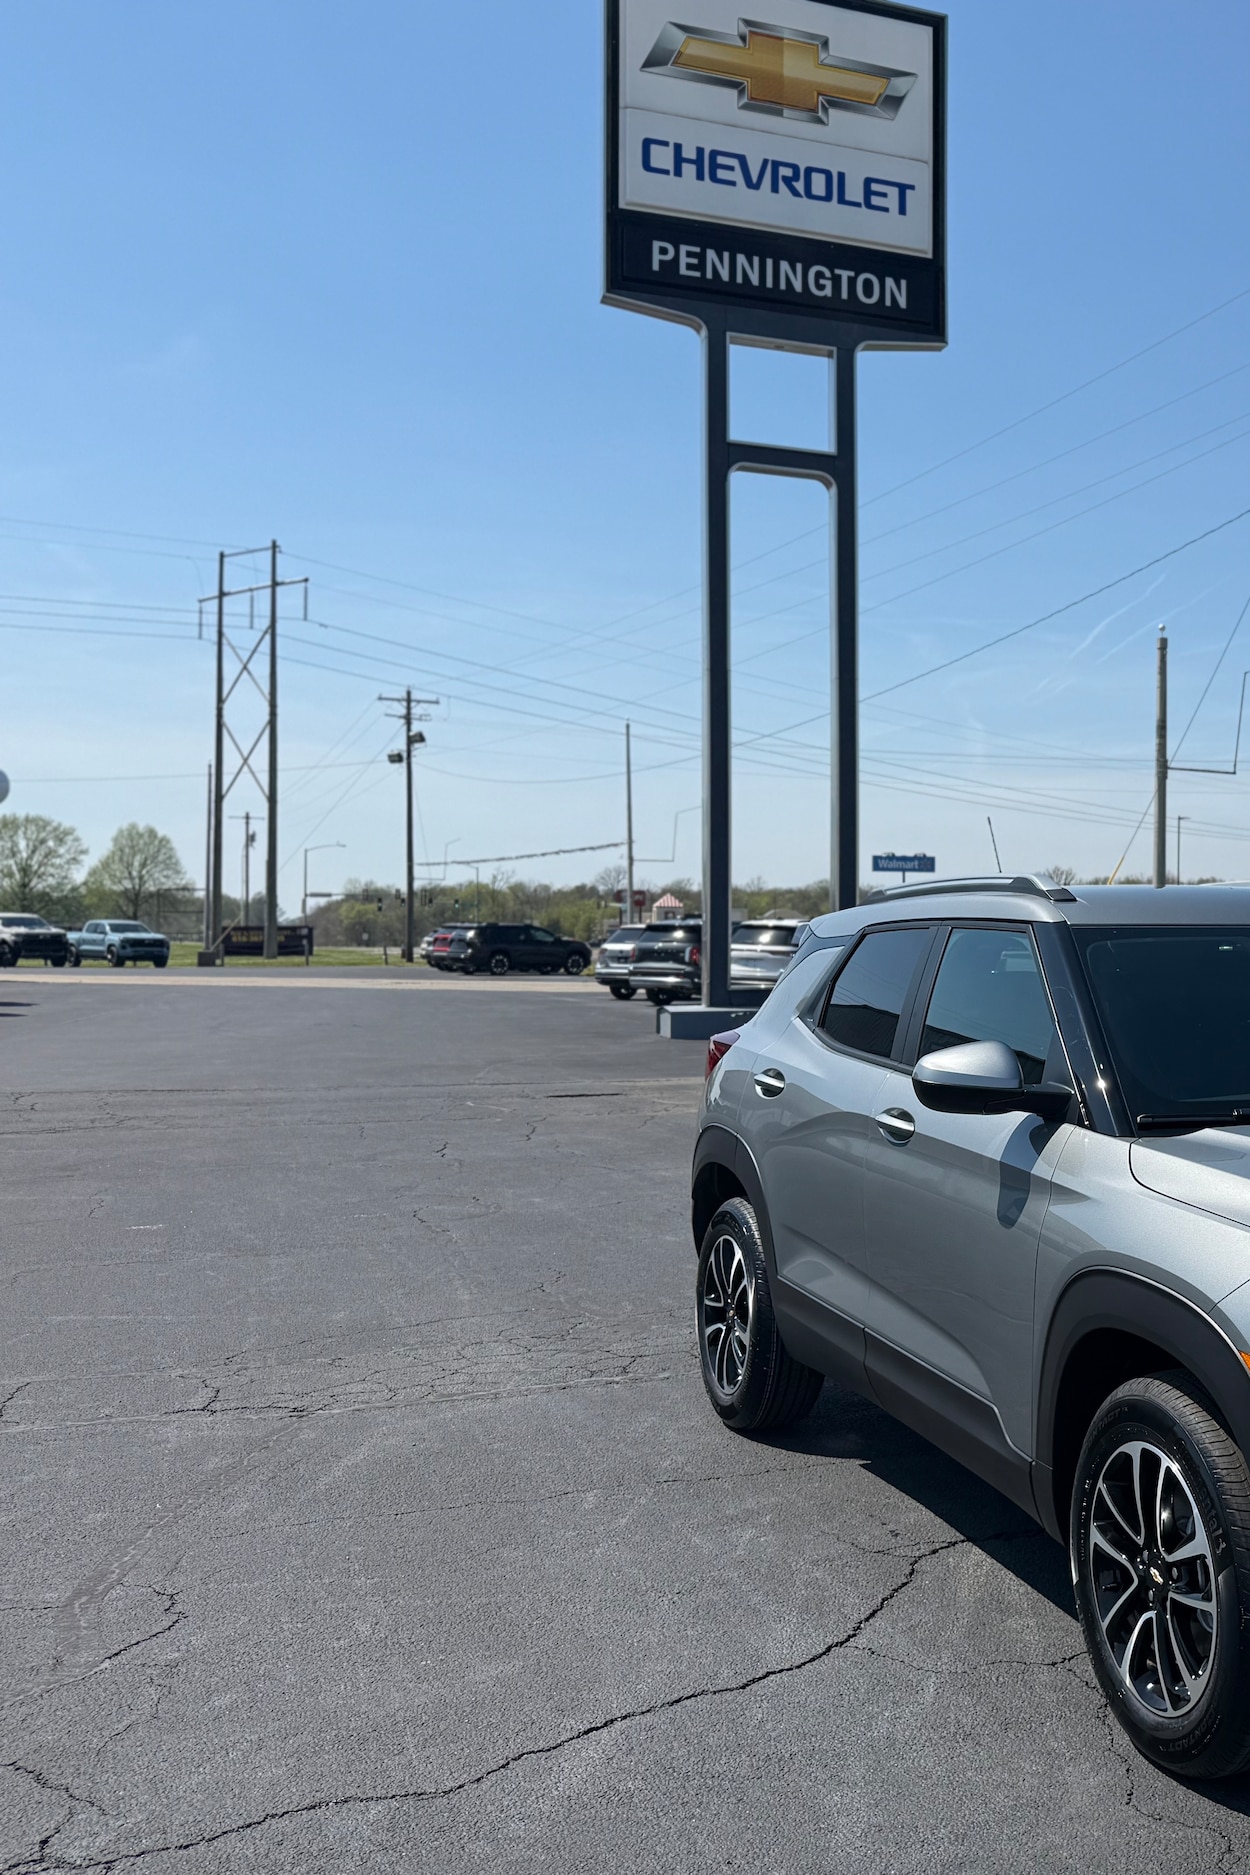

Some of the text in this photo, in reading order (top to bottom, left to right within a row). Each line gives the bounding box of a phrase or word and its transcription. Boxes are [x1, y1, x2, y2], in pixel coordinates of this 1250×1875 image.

[641, 137, 916, 216] CHEVROLET
[652, 240, 907, 309] PENNINGTON
[878, 858, 919, 869] Walmart
